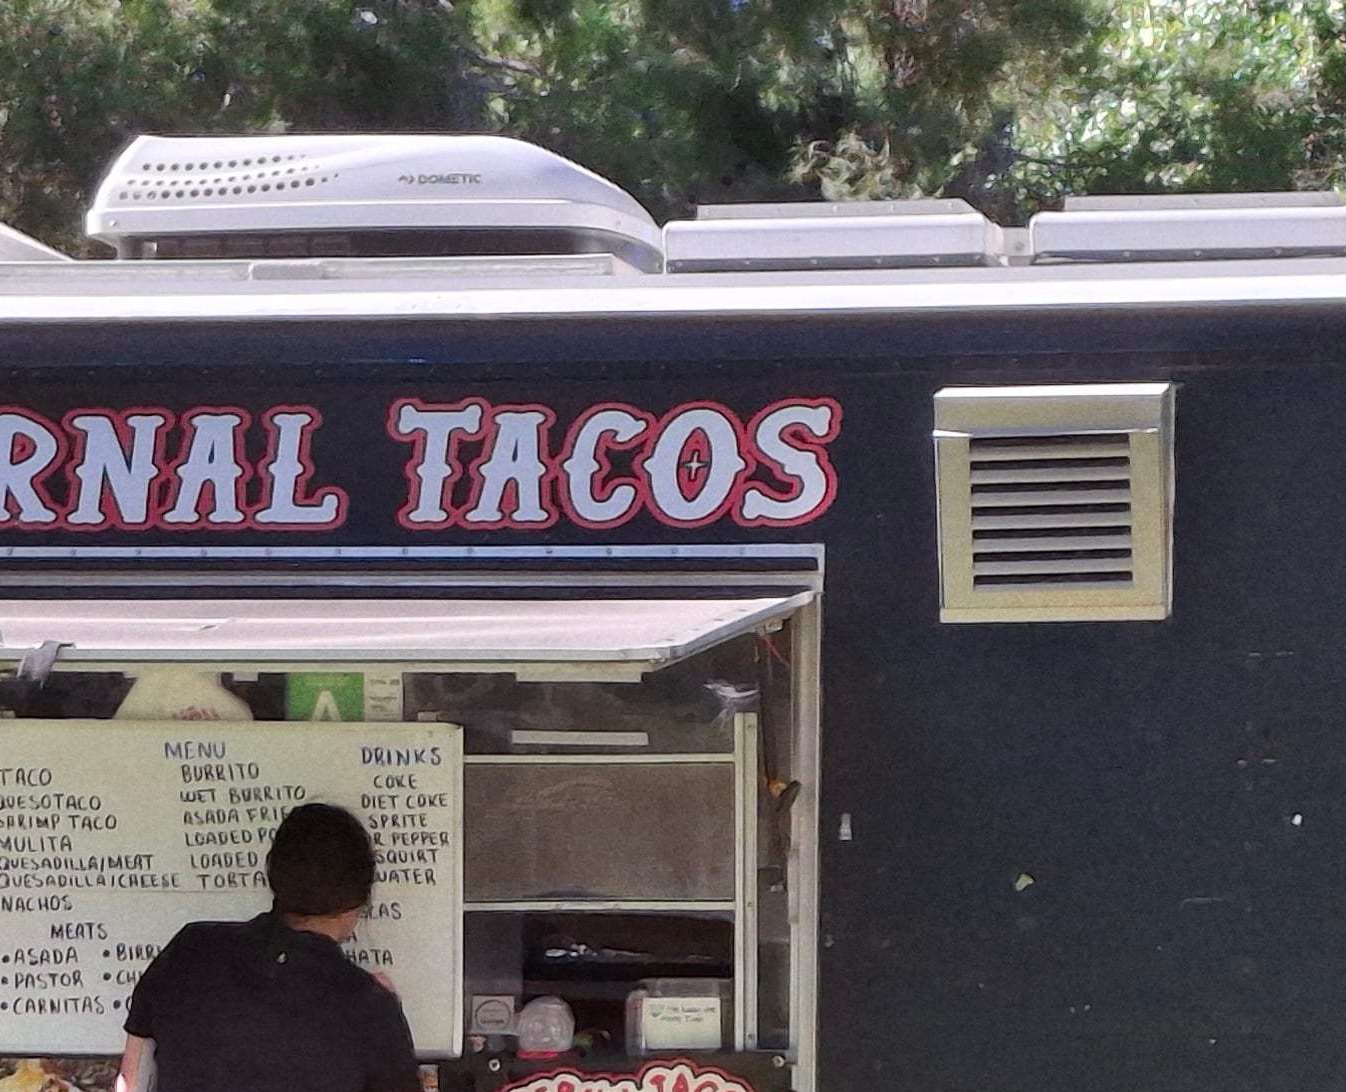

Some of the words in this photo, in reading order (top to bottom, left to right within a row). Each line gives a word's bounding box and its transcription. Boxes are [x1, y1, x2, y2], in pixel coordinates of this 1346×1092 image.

[391, 397, 841, 529] TACOS
[164, 741, 226, 760] MENU
[362, 746, 442, 766] DRINKS
[181, 762, 259, 783] BURRITO
[373, 773, 417, 789] COKE
[180, 788, 216, 803] WET
[229, 785, 306, 804] BURRITO
[361, 793, 399, 809] DIET
[406, 792, 448, 809] COKE
[68, 814, 117, 831] TACO
[183, 808, 239, 825] ASADA
[369, 813, 428, 829] SPRITE
[184, 829, 253, 847] LOADED
[391, 831, 450, 848] PEPPER
[190, 851, 258, 870] LOADED
[375, 848, 438, 864] SQUIRT
[1, 895, 73, 913] NACHOS
[50, 922, 108, 940] MEATS
[14, 946, 79, 966] ASADA
[14, 969, 84, 989] PASTOR
[13, 995, 105, 1015] CARNITAS
